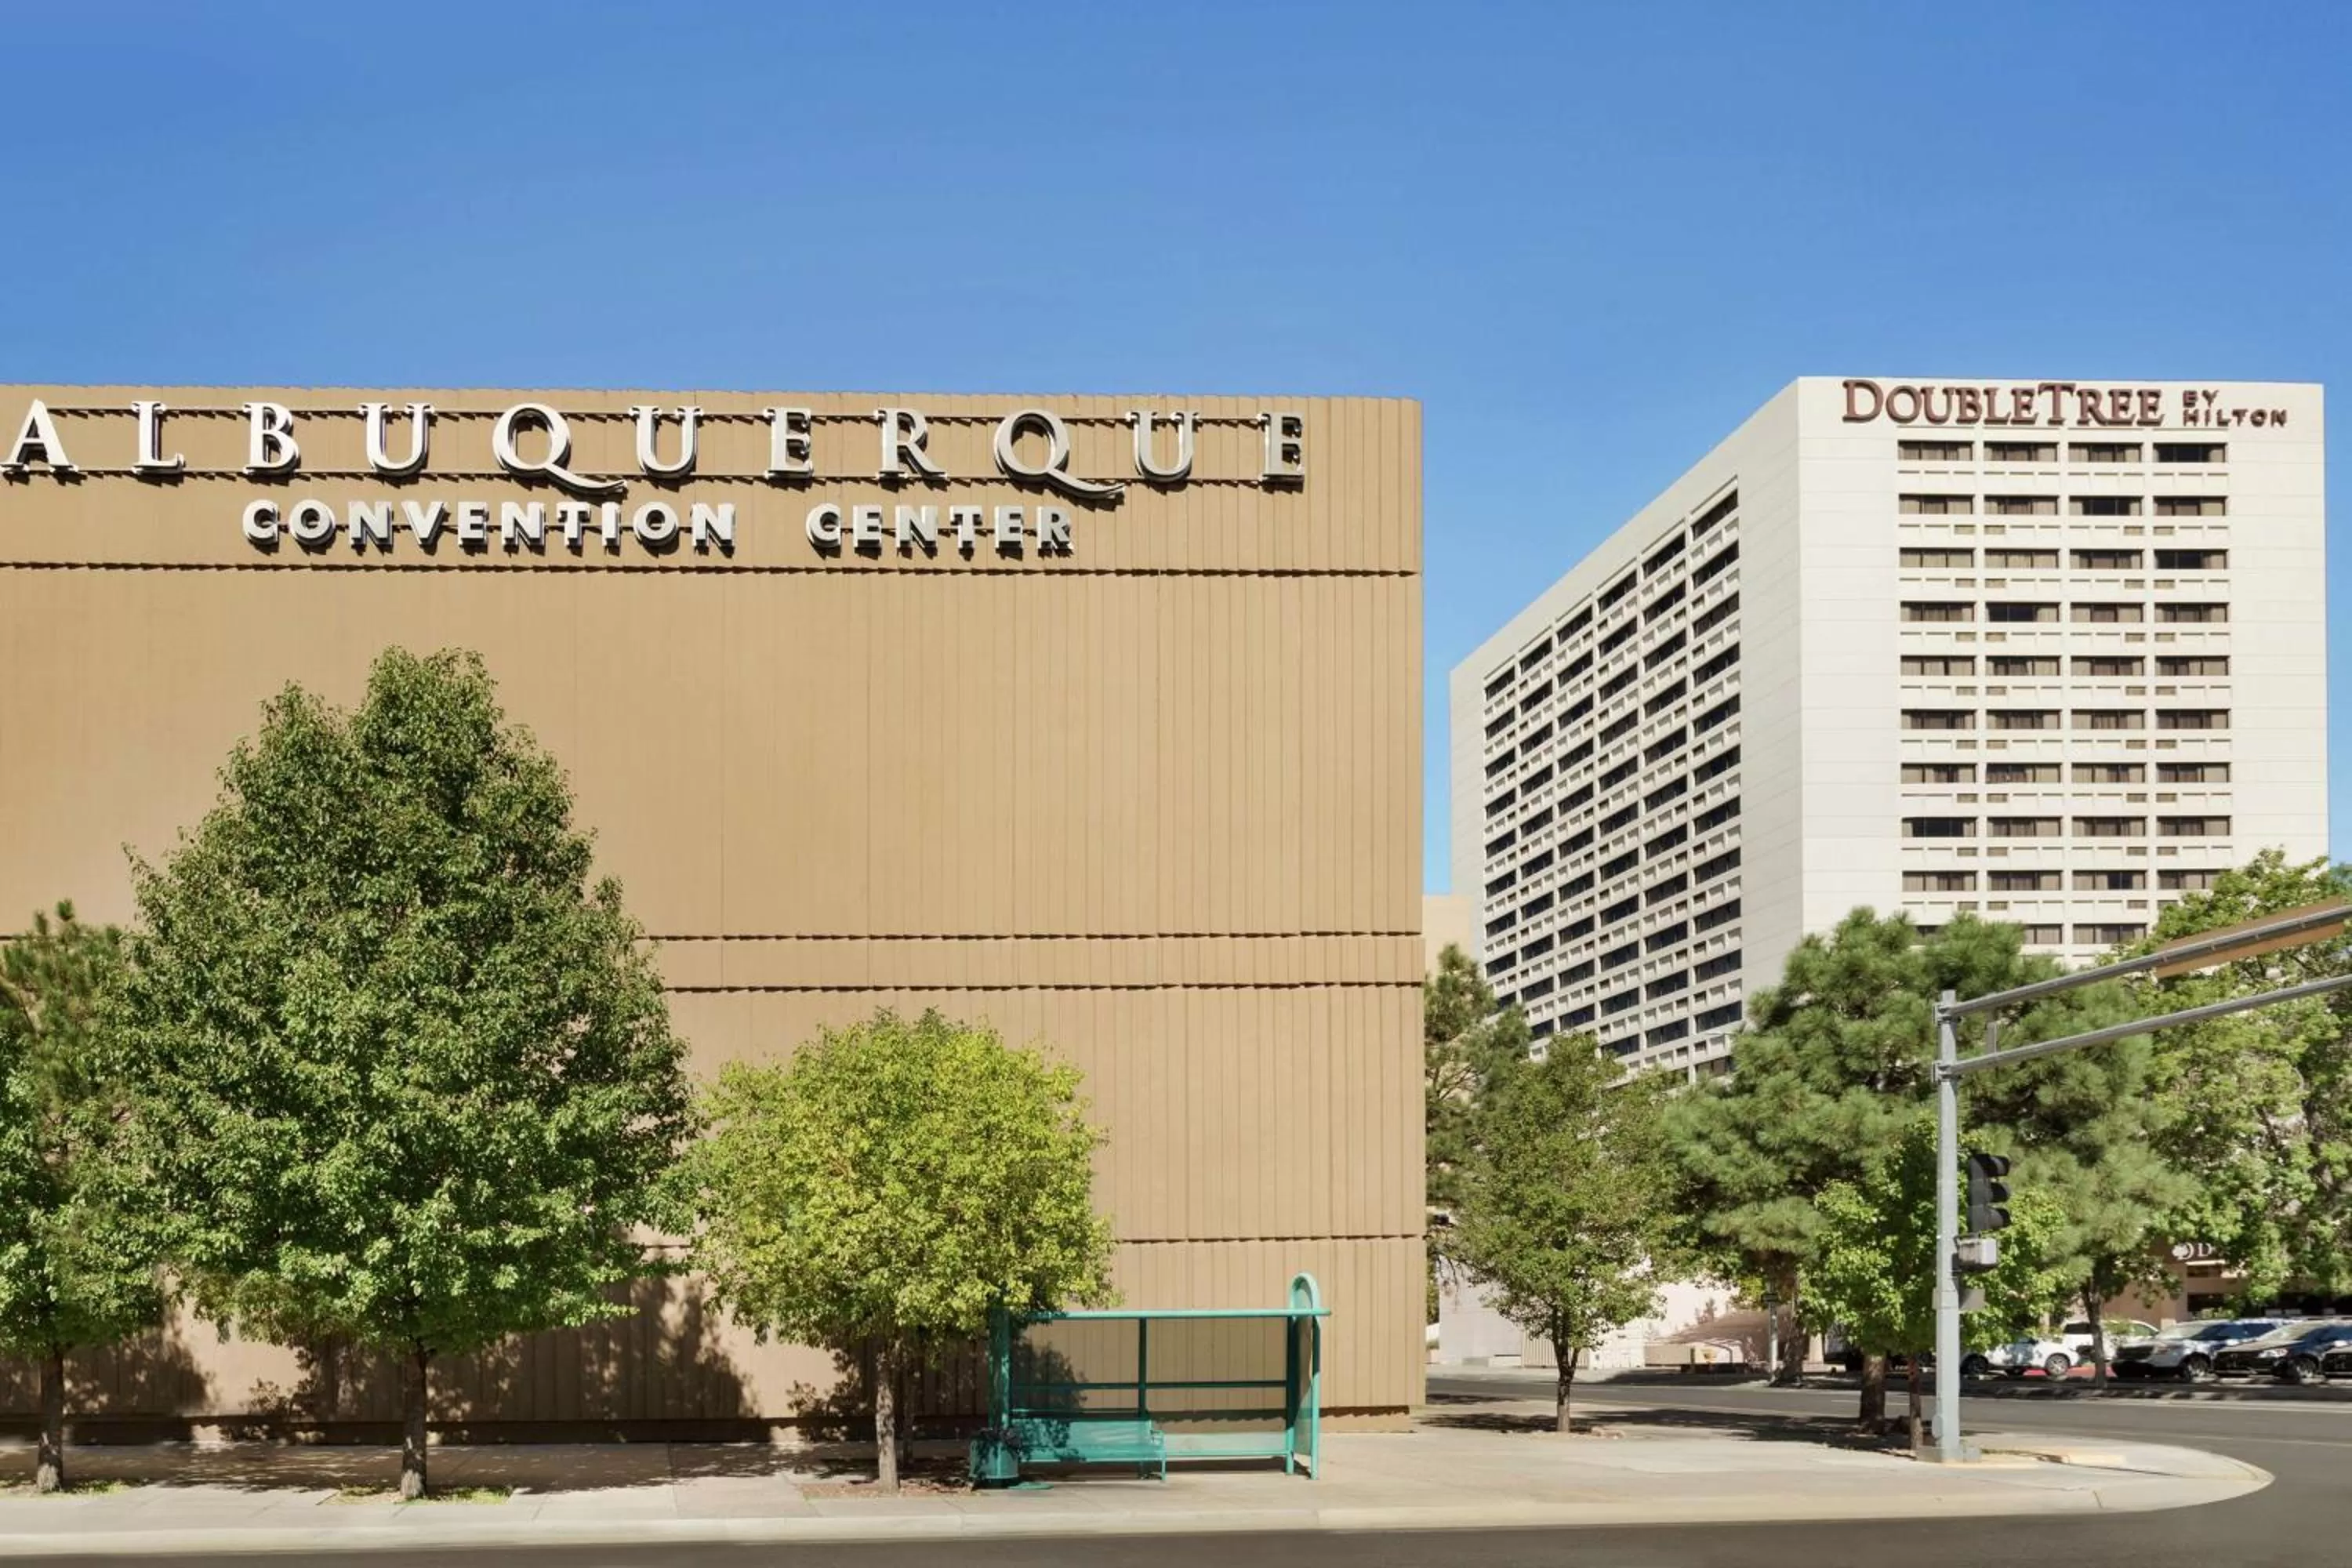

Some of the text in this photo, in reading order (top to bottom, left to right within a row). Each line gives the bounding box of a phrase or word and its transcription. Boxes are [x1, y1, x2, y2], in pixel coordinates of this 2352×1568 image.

[2183, 390, 2219, 408] BY
[2183, 408, 2287, 427] HILTON
[1, 398, 1305, 499] ALBUQUERQUE
[242, 499, 1074, 551] CONVENTION CENTER
